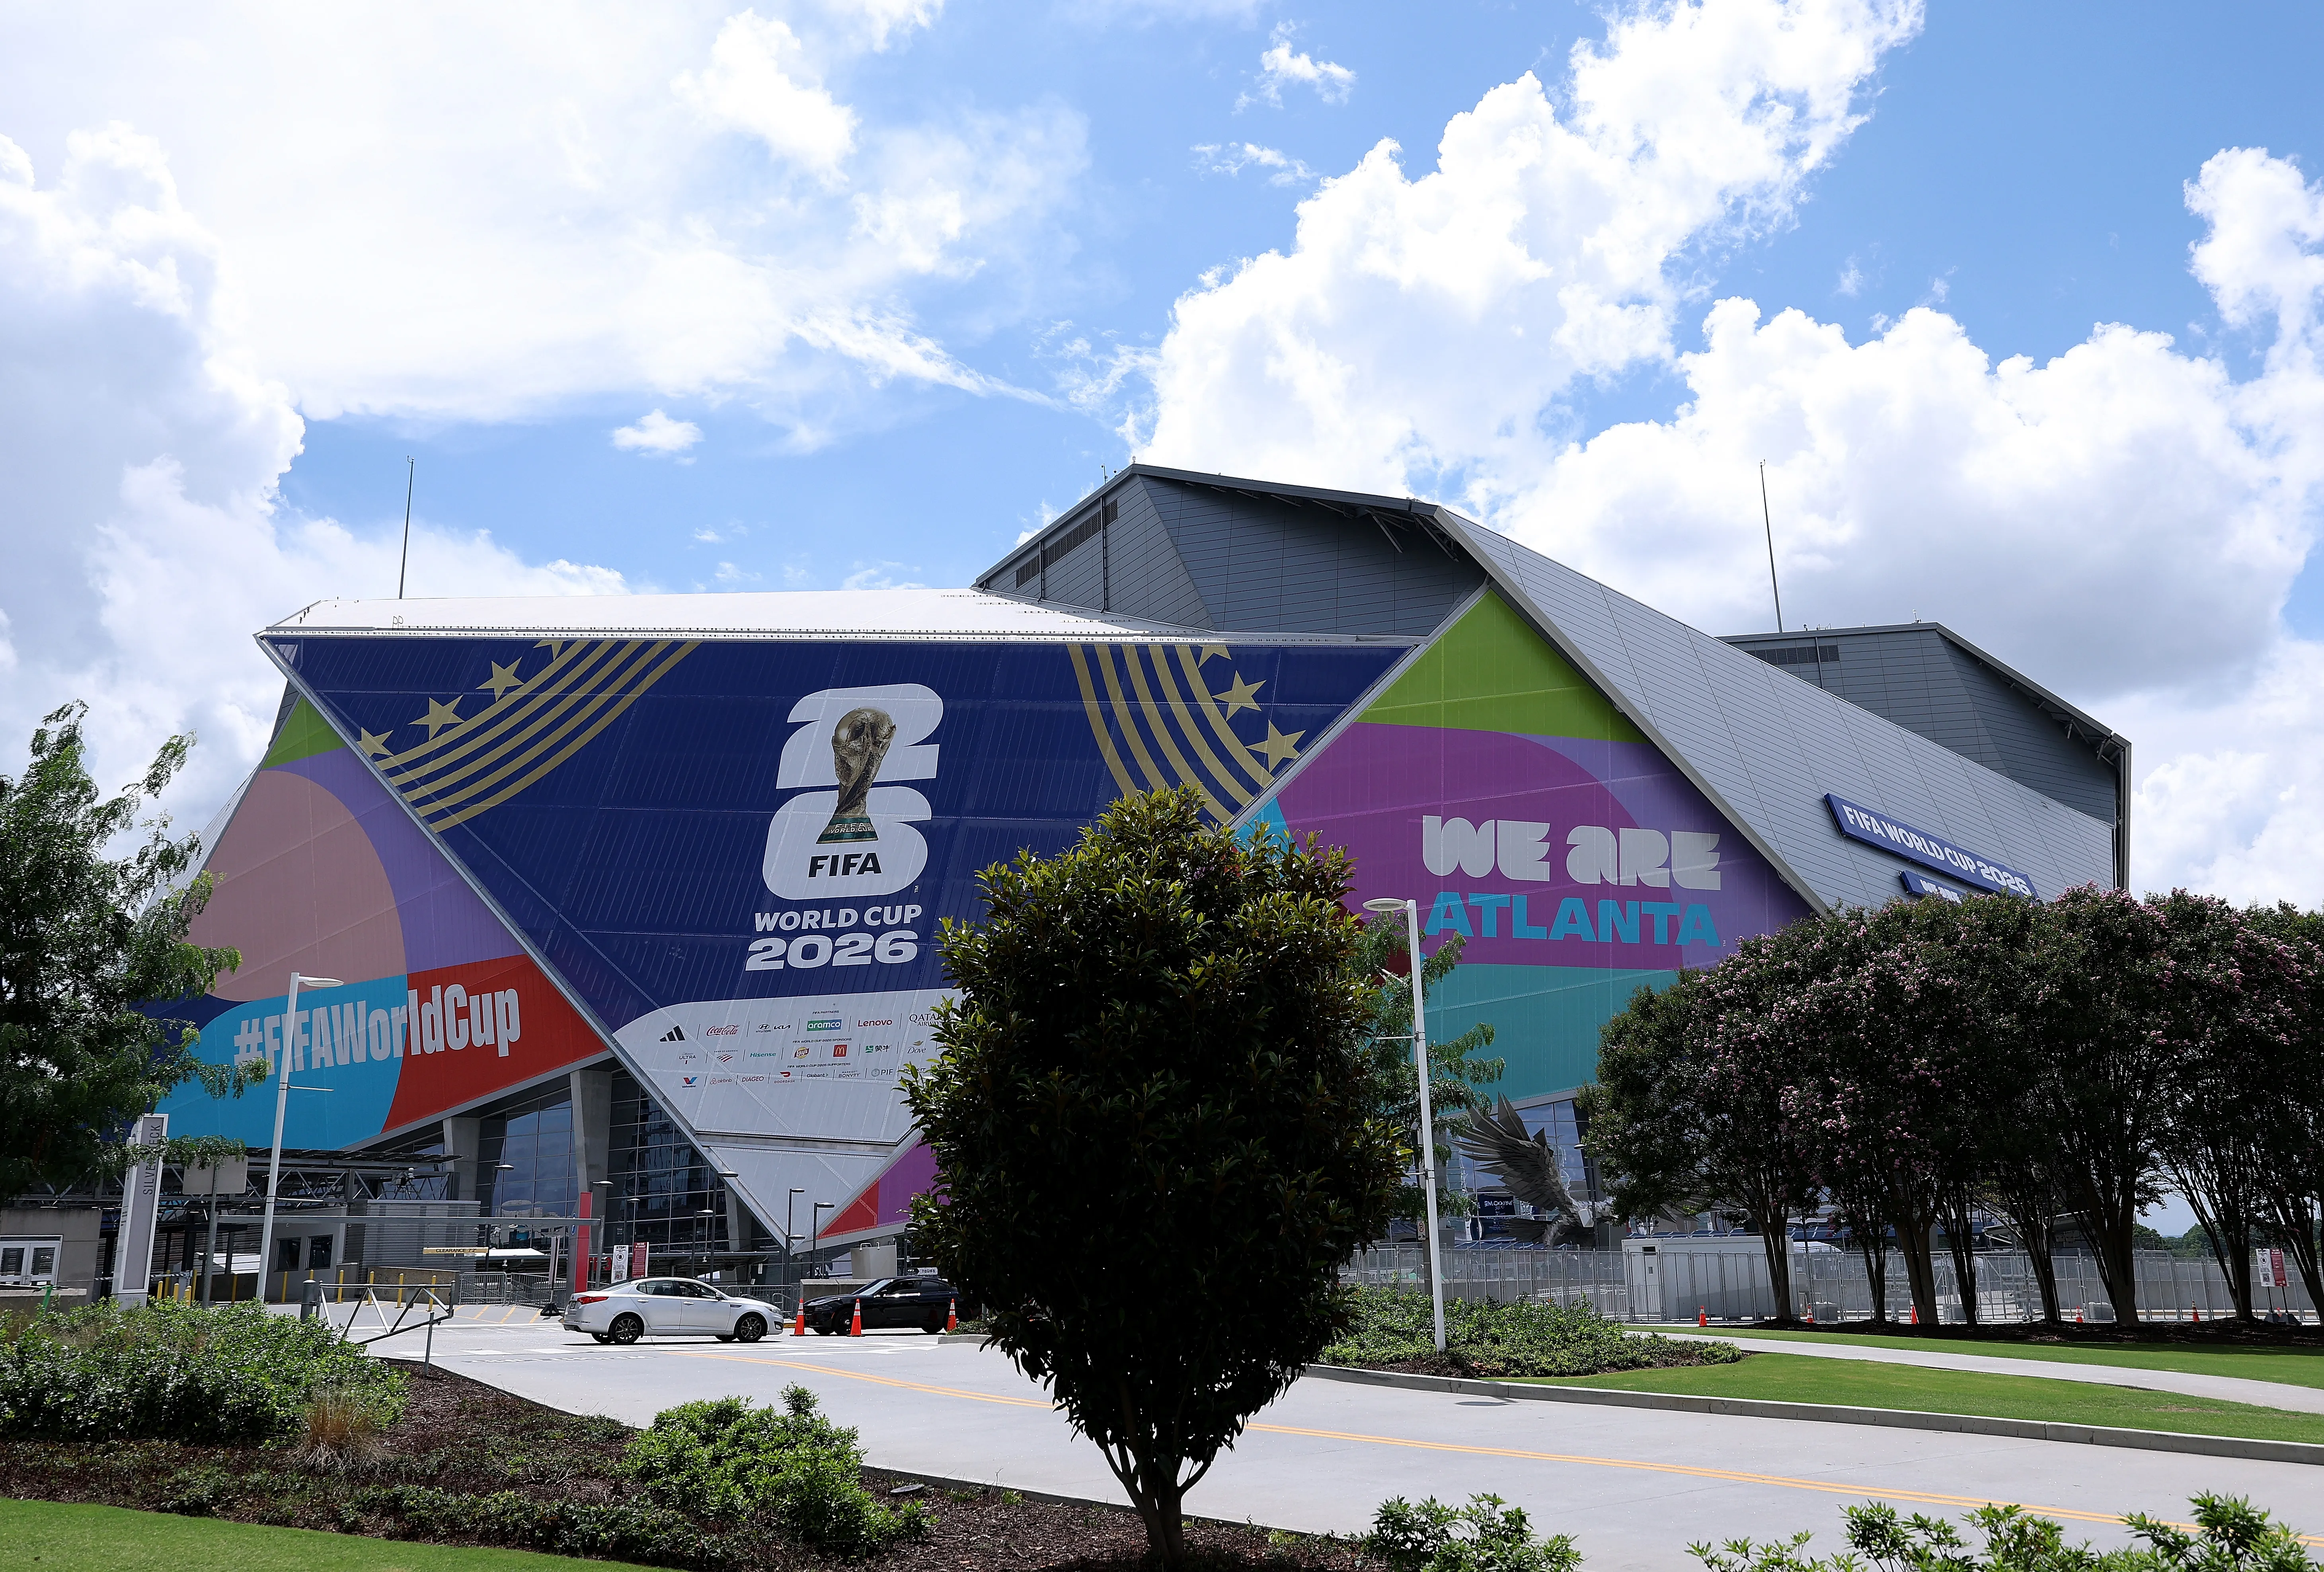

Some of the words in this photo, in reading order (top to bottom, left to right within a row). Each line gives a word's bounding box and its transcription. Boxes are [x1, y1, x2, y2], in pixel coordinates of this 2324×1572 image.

[808, 852, 882, 878] FIFA
[1423, 815, 1550, 882] WE
[1566, 825, 1721, 890] ARE
[1842, 805, 1887, 838] FIFA
[1881, 821, 1945, 860] WORLD
[1944, 847, 1976, 874] CUP
[1976, 861, 2032, 896] 2026
[755, 909, 858, 932] WORLD
[864, 904, 922, 928] CUP
[1424, 891, 1720, 947] ATLANTA
[745, 930, 918, 971] 2026
[909, 1013, 940, 1023] QATA
